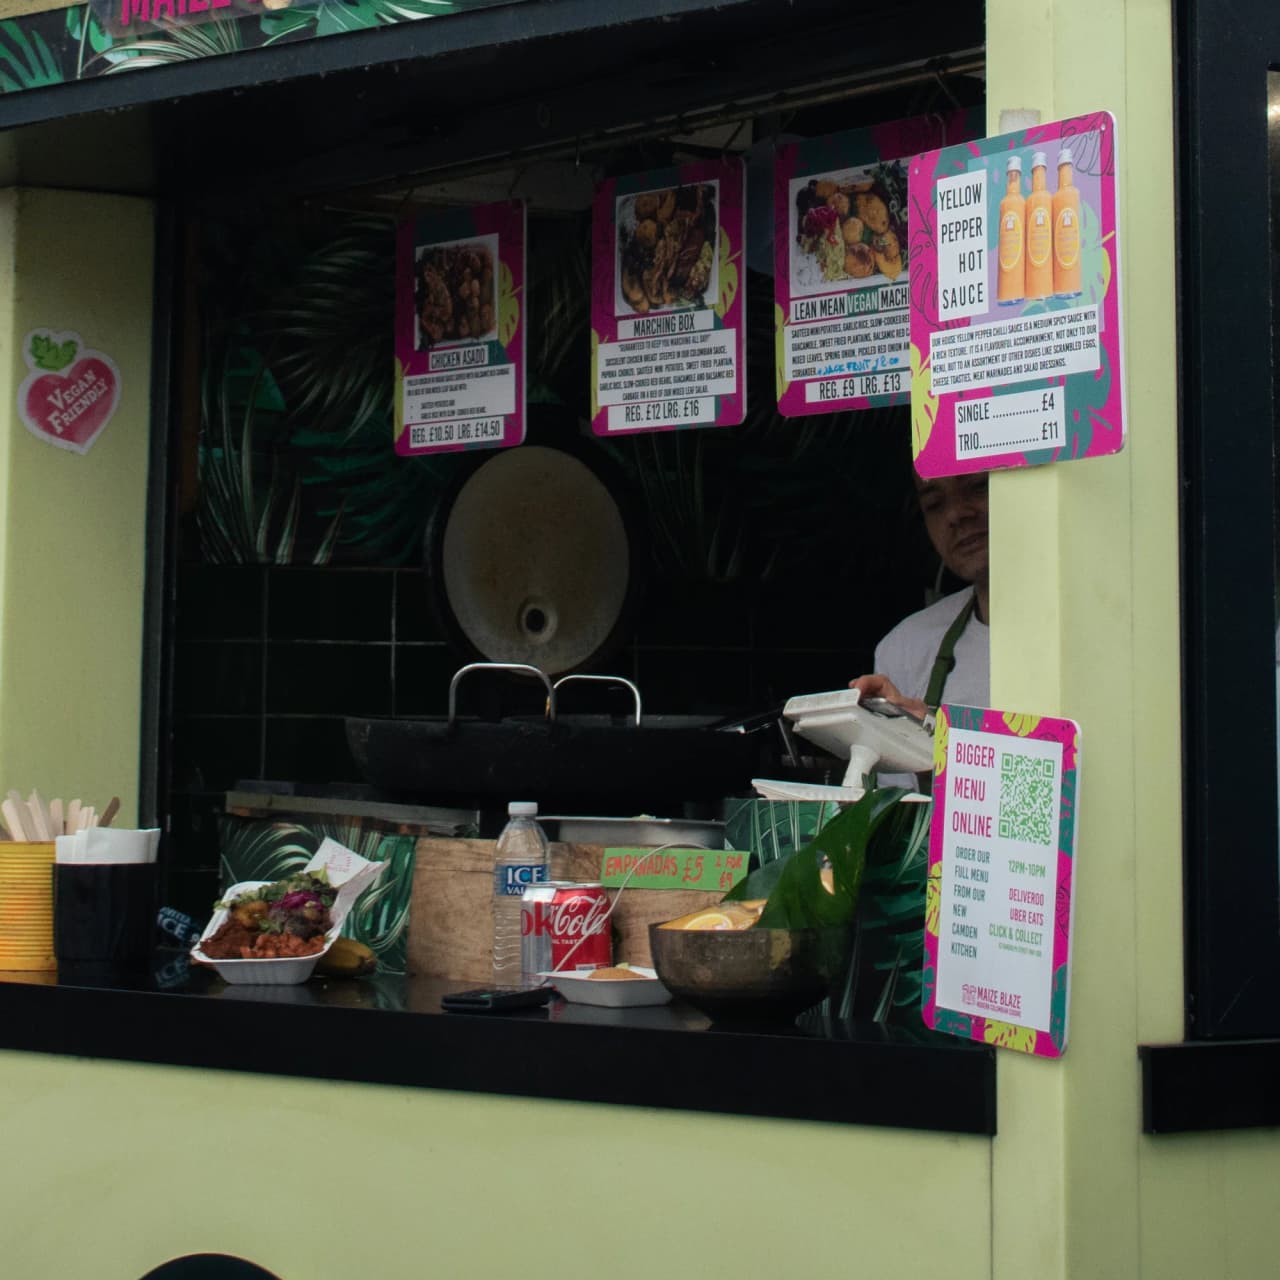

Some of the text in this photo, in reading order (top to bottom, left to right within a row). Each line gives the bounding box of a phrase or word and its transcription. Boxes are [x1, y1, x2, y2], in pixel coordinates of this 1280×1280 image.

[940, 183, 982, 211] YELLOW
[941, 217, 982, 244] PEPPER
[959, 250, 983, 273] HOT
[795, 301, 817, 320] LEAN
[820, 297, 845, 316] MEAN
[847, 292, 878, 313] VEGAN
[943, 283, 983, 309] SAUCE
[634, 314, 694, 336] MARCHING BOX
[957, 332, 974, 343] YELLOW
[975, 329, 992, 340] PEPPER
[1008, 324, 1022, 335] SAUCE
[1034, 319, 1052, 331] MEDIUM
[1054, 316, 1066, 328] SPICY
[1067, 314, 1083, 325] SAUCE
[1084, 311, 1096, 322] WITH
[431, 352, 460, 370] CHICKEN
[47, 369, 97, 411] VEGAN
[820, 374, 900, 400] REG. £9 LRG. £13
[47, 377, 109, 434] FRIENDLY
[626, 400, 699, 422] REG. £12 LRG. £16
[958, 392, 1055, 423] SINGLE £4
[412, 420, 500, 444] REG. £10.50 LRG. £14.50
[1041, 422, 1058, 441] £11
[956, 742, 995, 769] BIGGER
[954, 776, 986, 802] MENU
[952, 810, 992, 838] ONLINE
[955, 846, 990, 864] ORDER OUR
[604, 855, 678, 877] EMPANADAS
[682, 856, 704, 882] £5
[955, 865, 989, 883] FULL MENU
[953, 884, 986, 902] FROM OUR
[1008, 888, 1045, 907] DELIVEROO
[953, 903, 967, 918] NEW
[1010, 908, 1044, 926] UBER EATS
[952, 923, 978, 940] CAMDEN
[989, 924, 1007, 939] CLICK
[1015, 928, 1043, 946] COLLECT
[950, 943, 977, 959] KITCHEN
[977, 986, 998, 1004] MAIZE
[1000, 992, 1022, 1009] BLAZE
